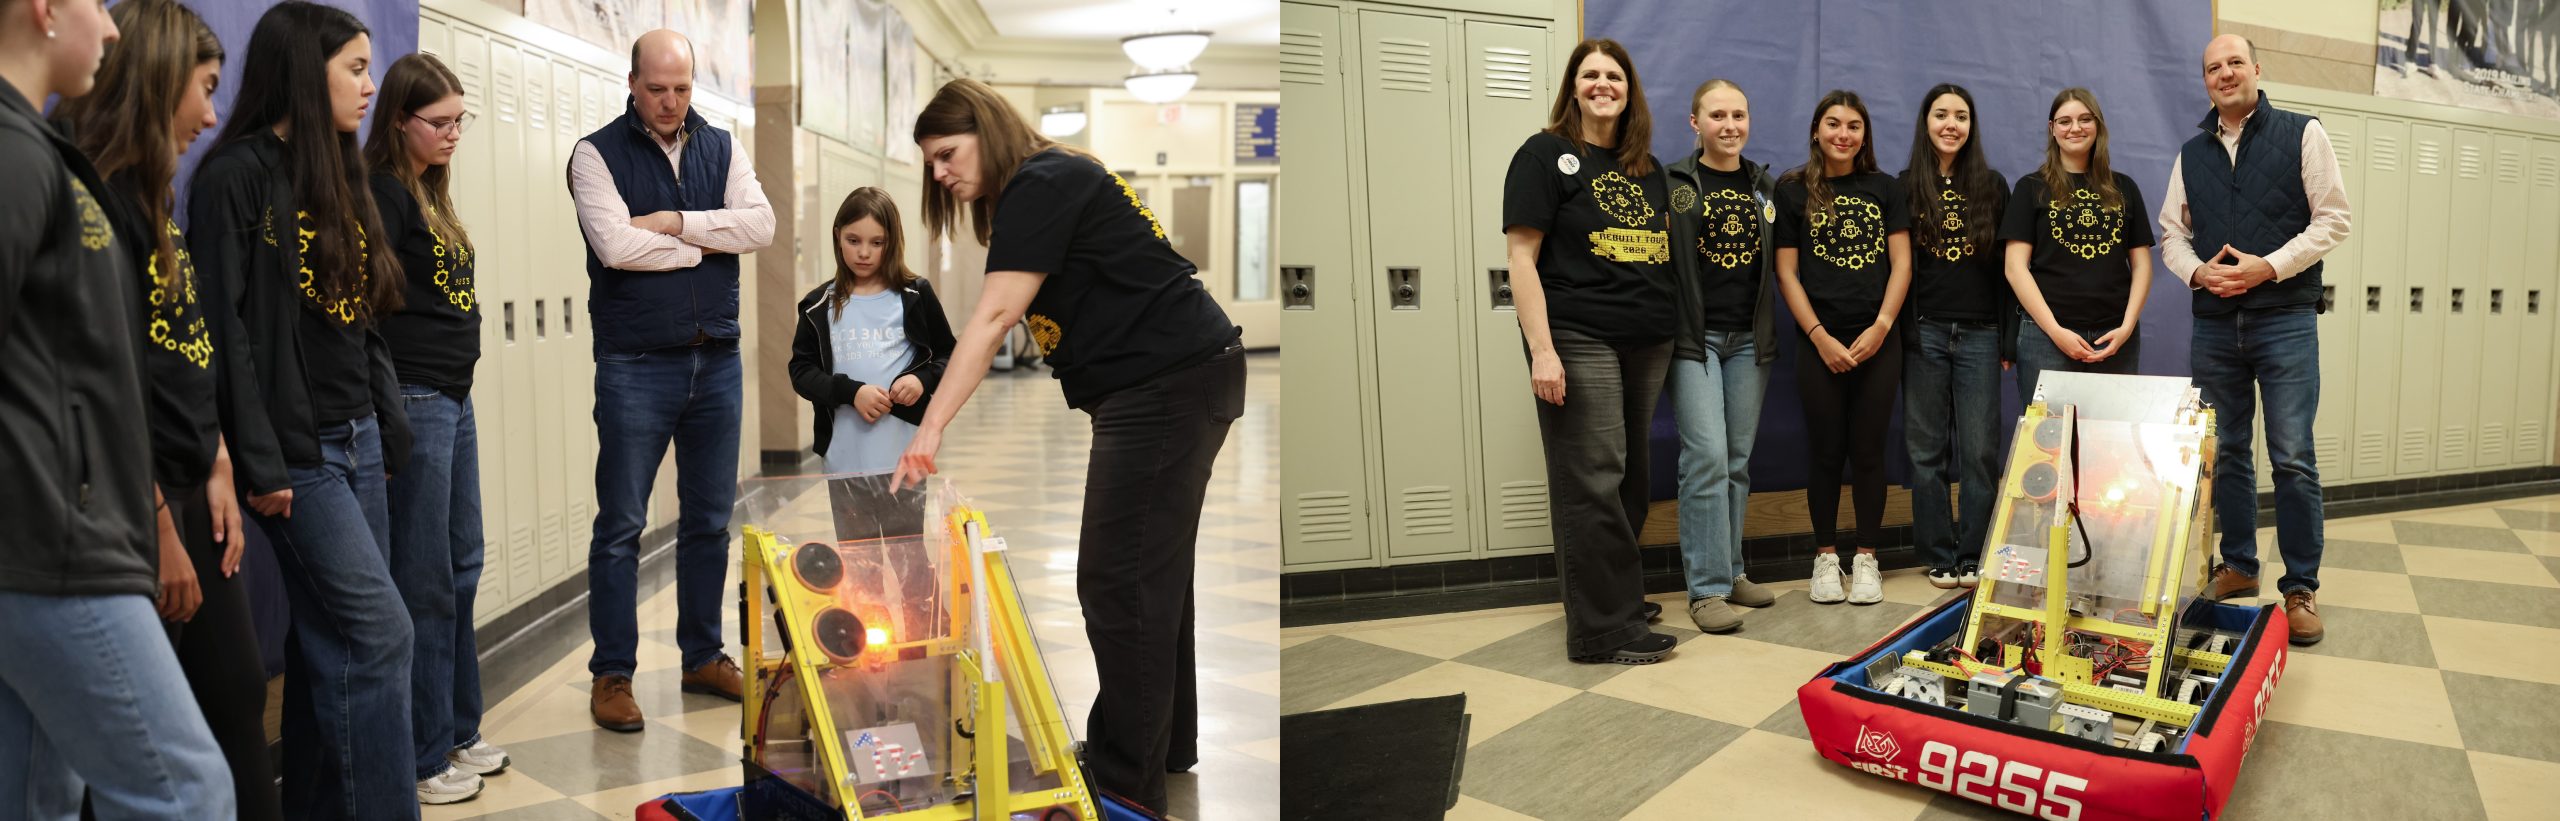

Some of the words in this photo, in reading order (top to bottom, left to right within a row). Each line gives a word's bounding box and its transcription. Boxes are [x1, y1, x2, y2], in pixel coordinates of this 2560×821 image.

[2474, 68, 2498, 80] 2019
[1708, 204, 1758, 238] BOTMASTERN
[1600, 233, 1641, 242] REBUILT
[1838, 243, 1868, 253] 9255
[1917, 740, 2089, 821] 9255
